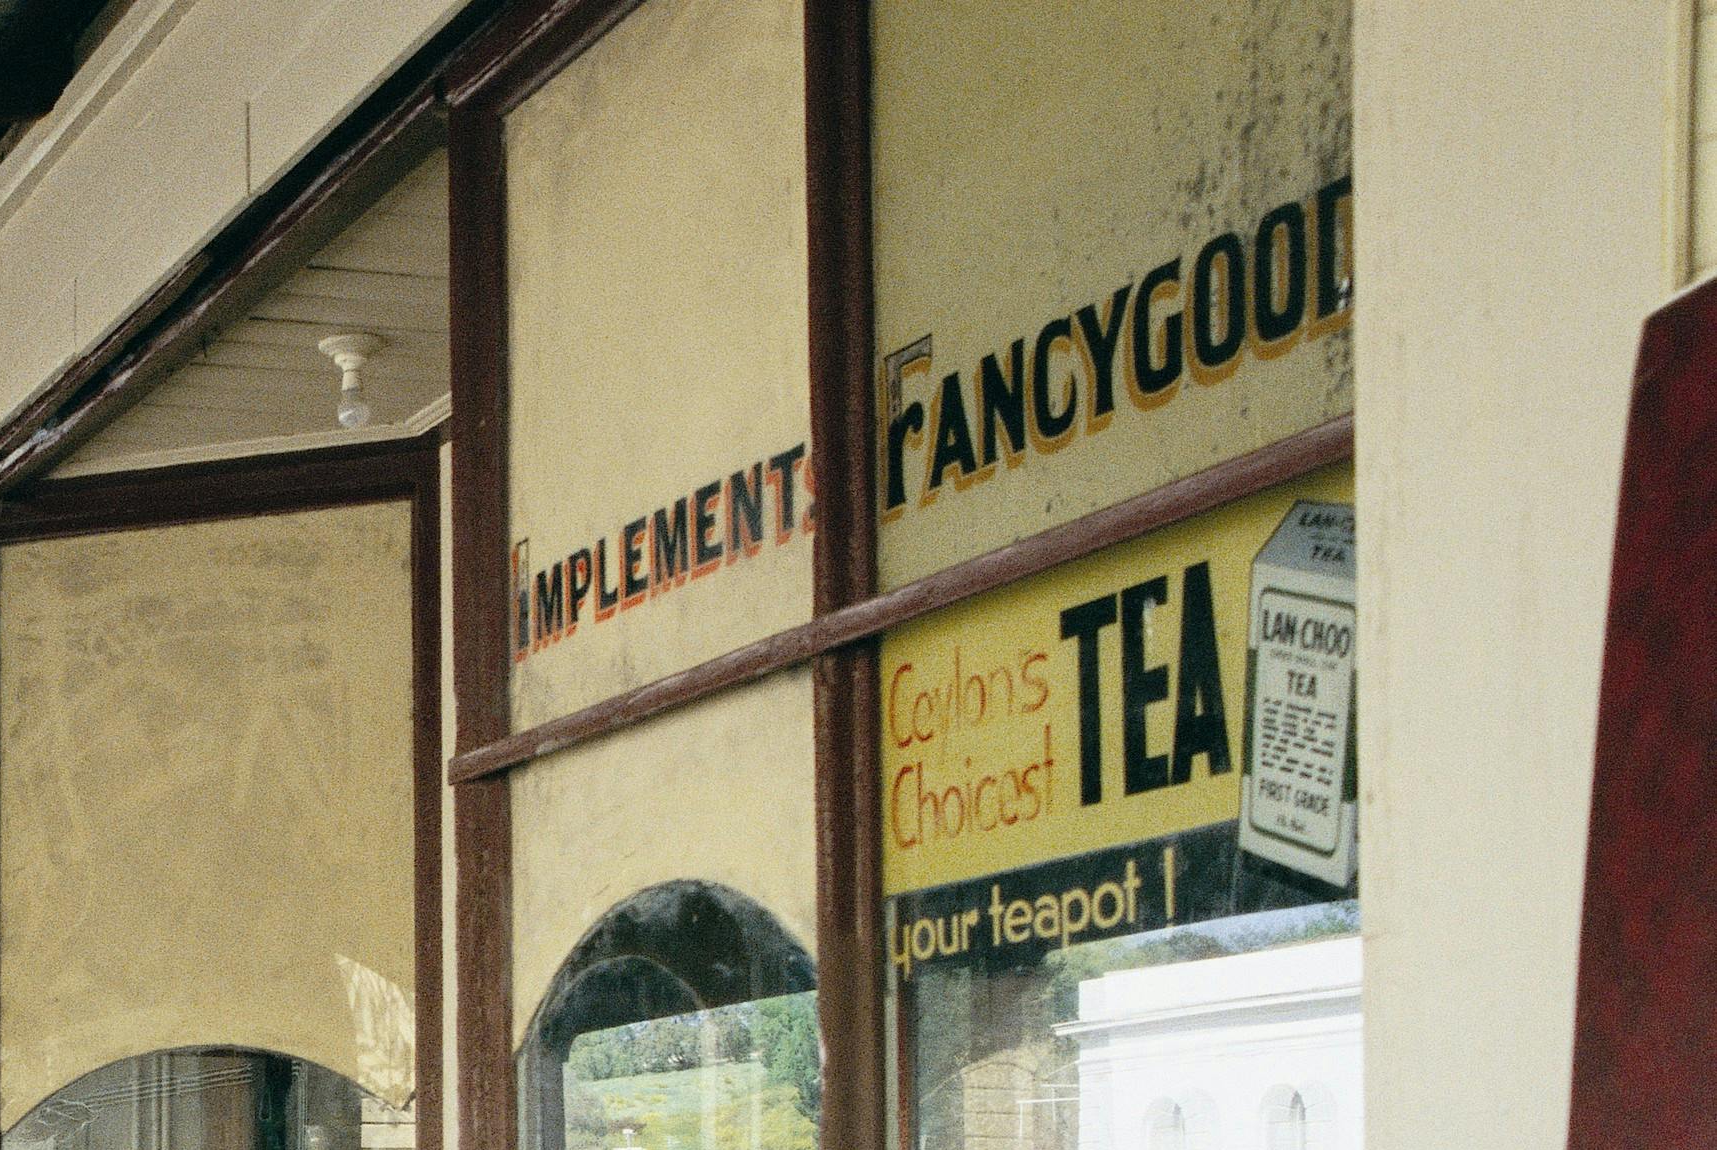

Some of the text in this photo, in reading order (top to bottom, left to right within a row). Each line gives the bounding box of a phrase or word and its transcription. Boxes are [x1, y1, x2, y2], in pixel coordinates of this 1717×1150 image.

[1262, 607, 1297, 646] LAN
[1059, 560, 1232, 808] TEA
[1287, 669, 1318, 699] TEA
[889, 908, 979, 981] your
[988, 867, 1142, 950] teapot
